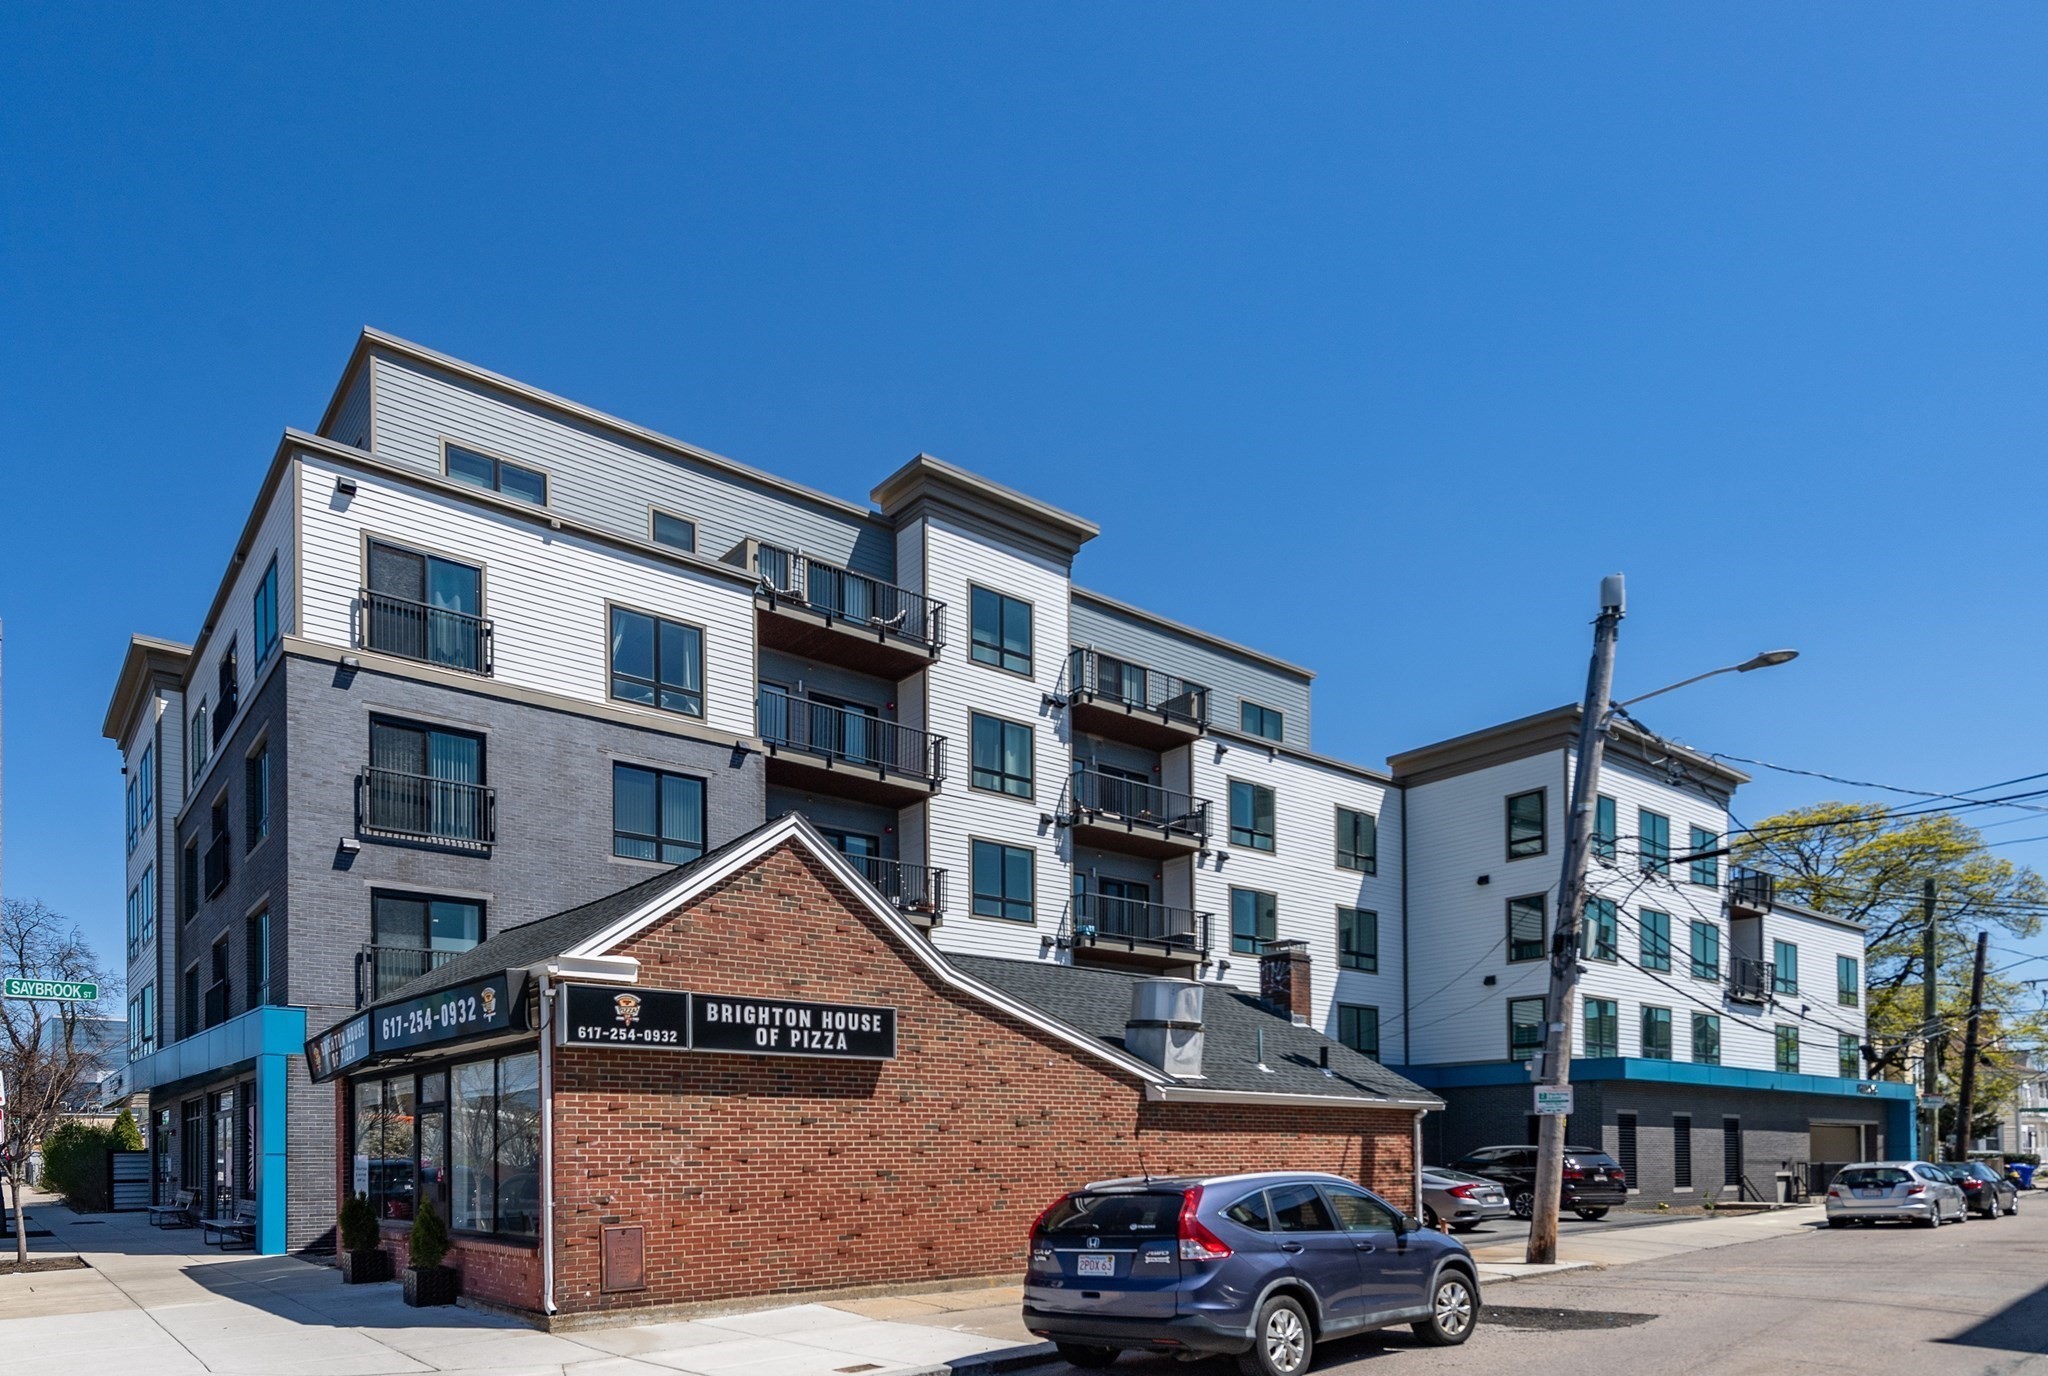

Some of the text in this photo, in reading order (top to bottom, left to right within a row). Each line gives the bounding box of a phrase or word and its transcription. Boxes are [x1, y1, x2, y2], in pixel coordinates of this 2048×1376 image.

[11, 981, 81, 998] SAYBROOK
[382, 996, 477, 1040] 617-254-0932
[706, 1003, 882, 1032] BRIGHTON HOUSE
[577, 1026, 677, 1043] 617-254-0932
[755, 1029, 848, 1050] OF PIZZA
